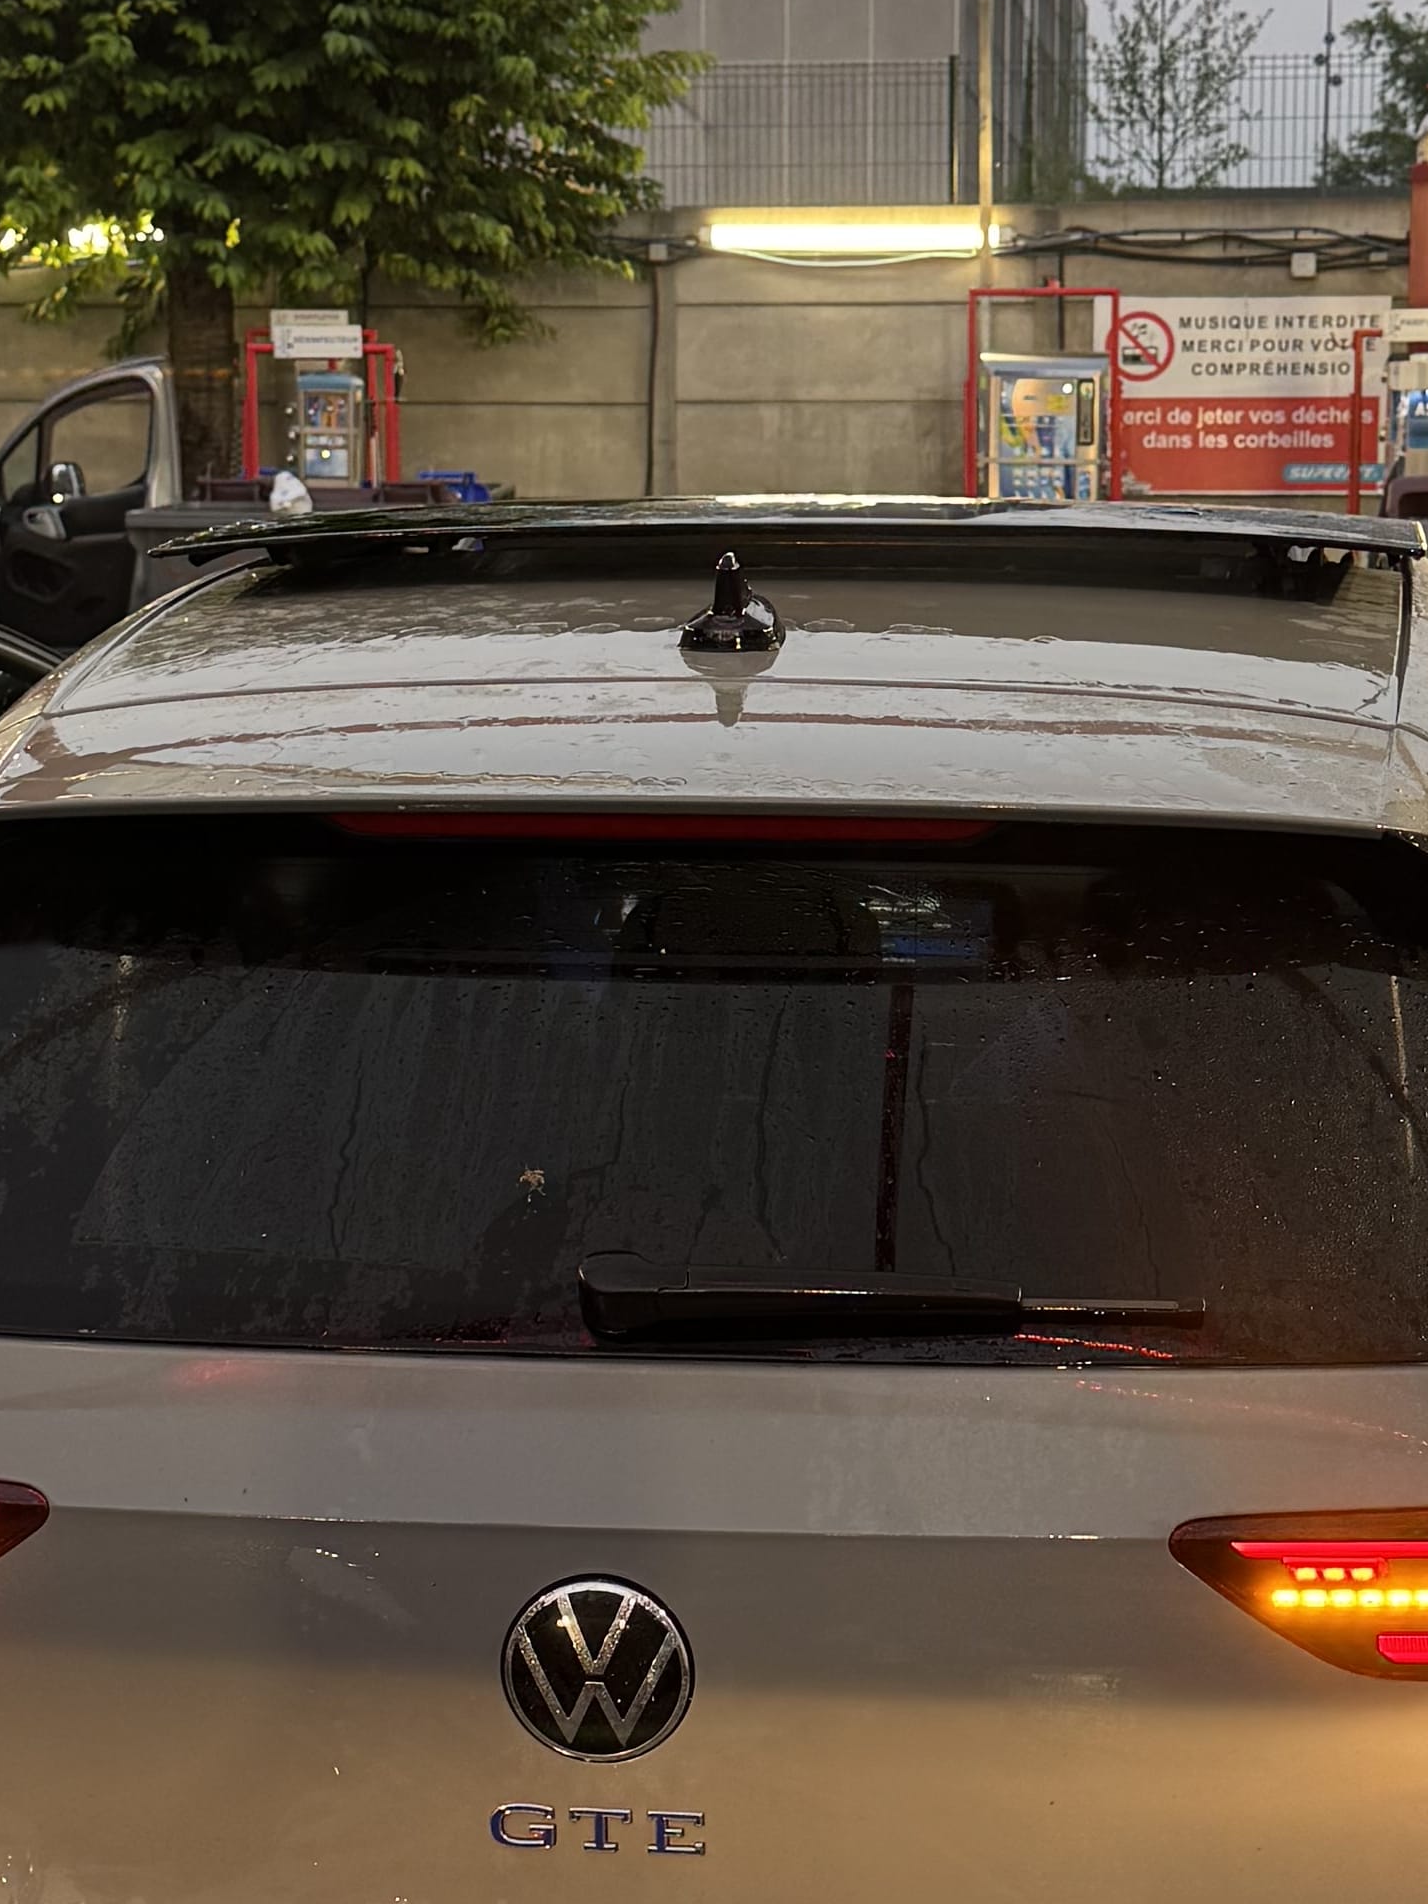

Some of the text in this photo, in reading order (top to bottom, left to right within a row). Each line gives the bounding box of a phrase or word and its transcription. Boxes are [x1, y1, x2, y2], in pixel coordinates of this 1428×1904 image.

[1178, 313, 1381, 330] MUSIQUE INTERDITE
[1181, 338, 1244, 353] MERCI
[1249, 338, 1304, 353] POUR
[1166, 406, 1193, 425] de
[1195, 406, 1245, 430] jeter
[1248, 408, 1286, 425] vos
[1142, 429, 1335, 449] dans les corbeilles
[489, 1801, 706, 1856] GTE
